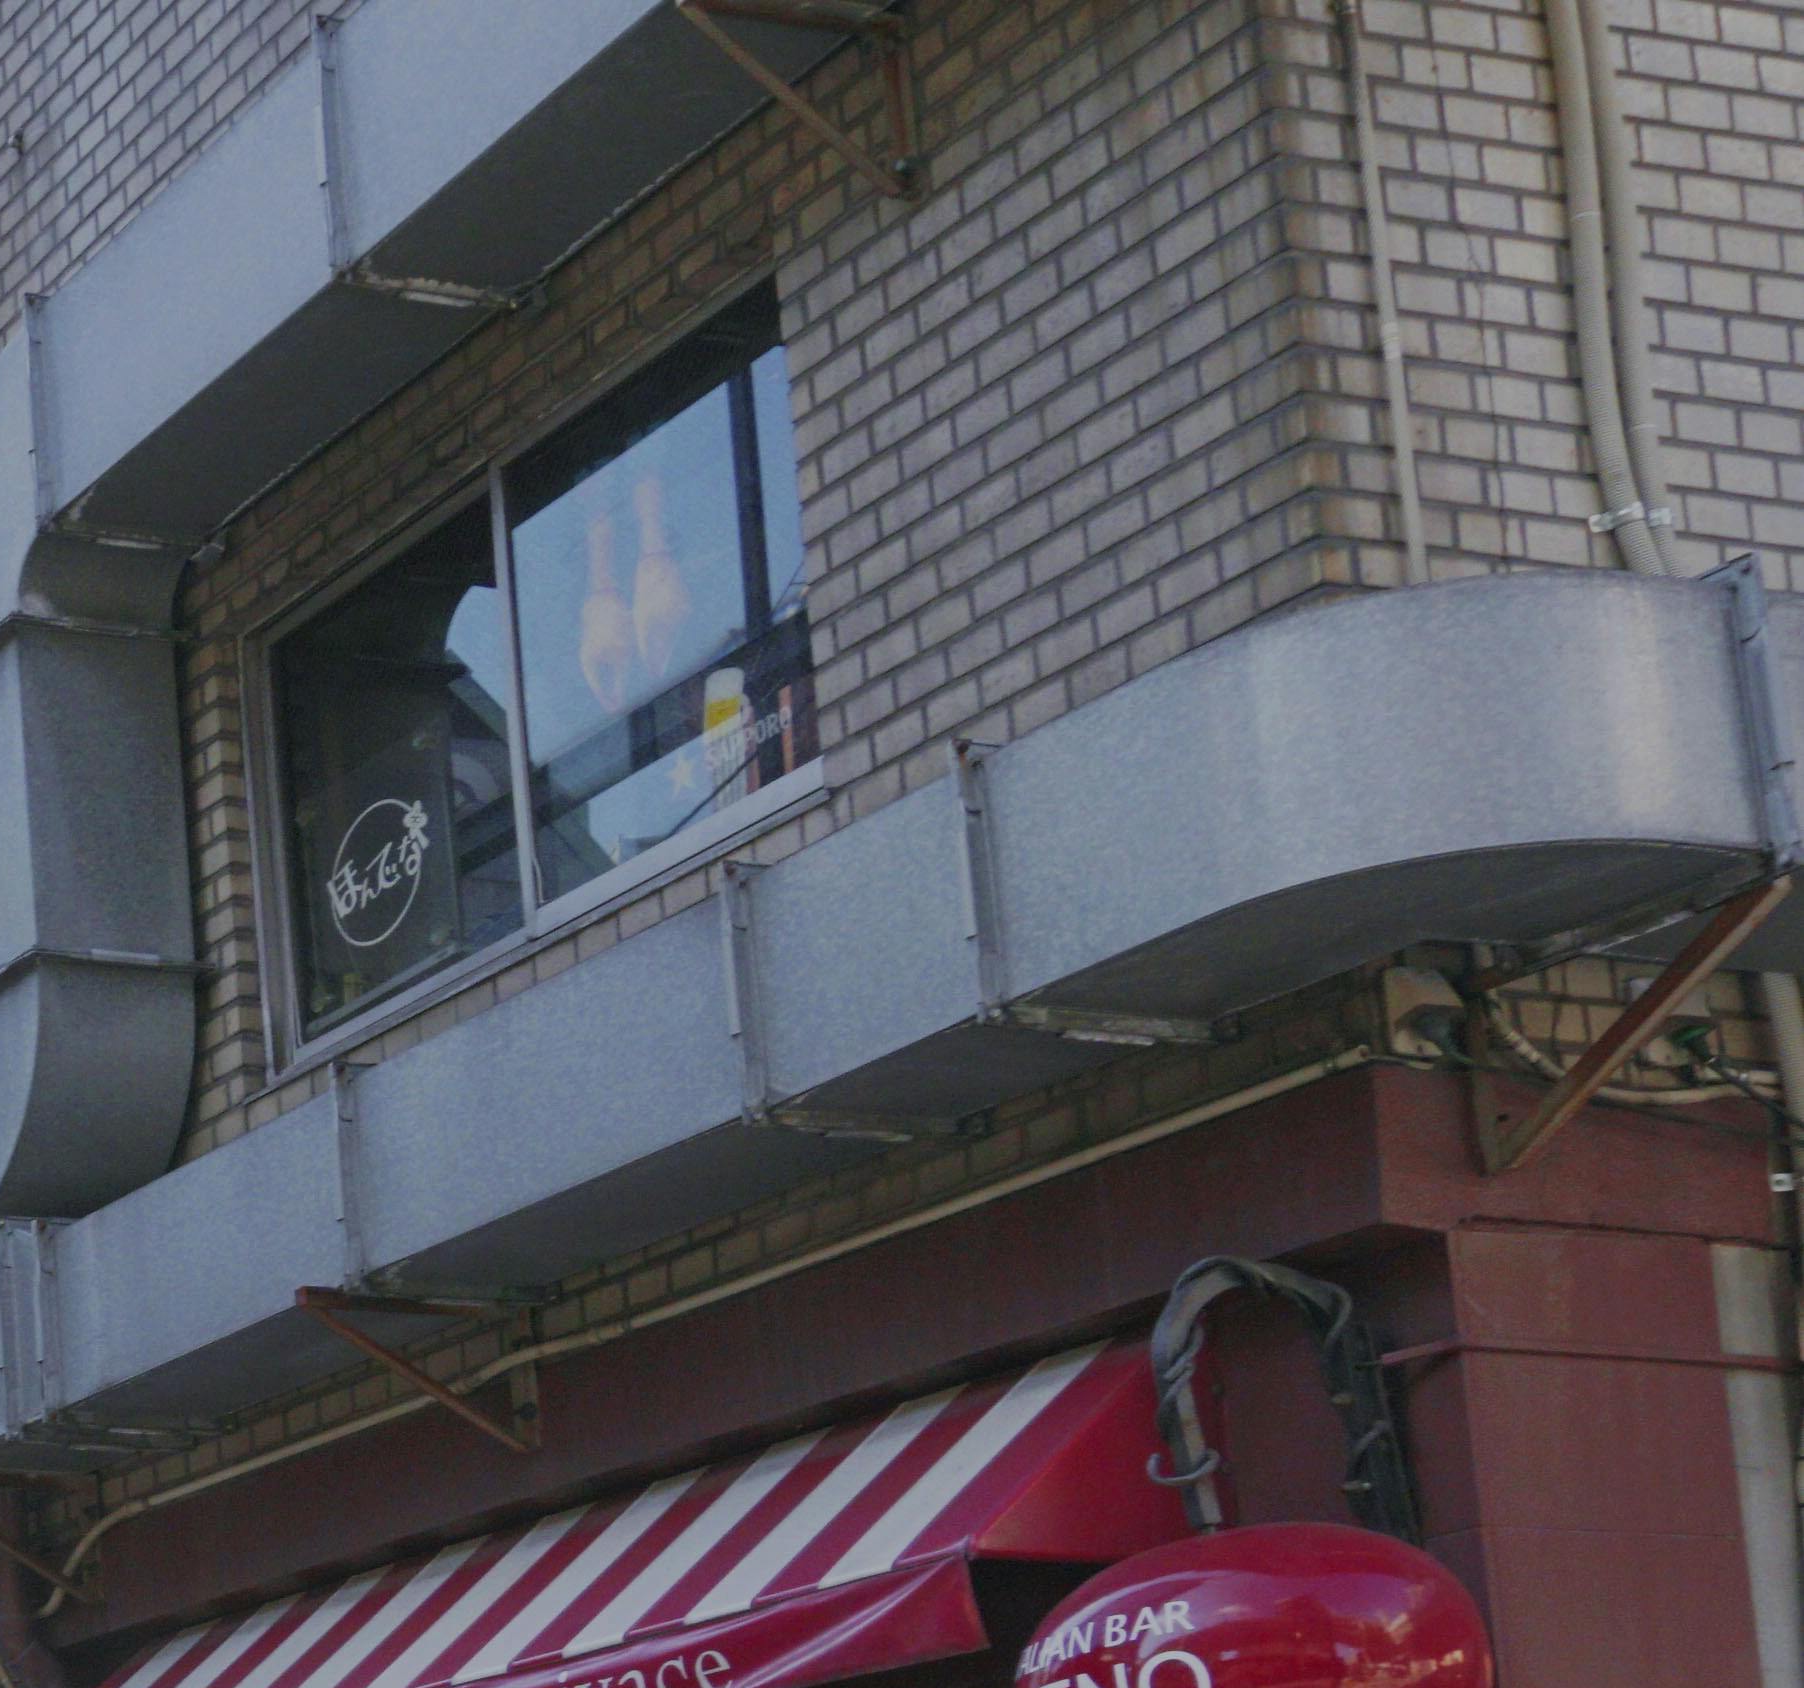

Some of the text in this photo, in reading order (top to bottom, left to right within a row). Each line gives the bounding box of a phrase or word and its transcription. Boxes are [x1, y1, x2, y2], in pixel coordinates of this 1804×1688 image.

[326, 835, 425, 918] ほんでな
[1102, 1600, 1195, 1648] BAR
